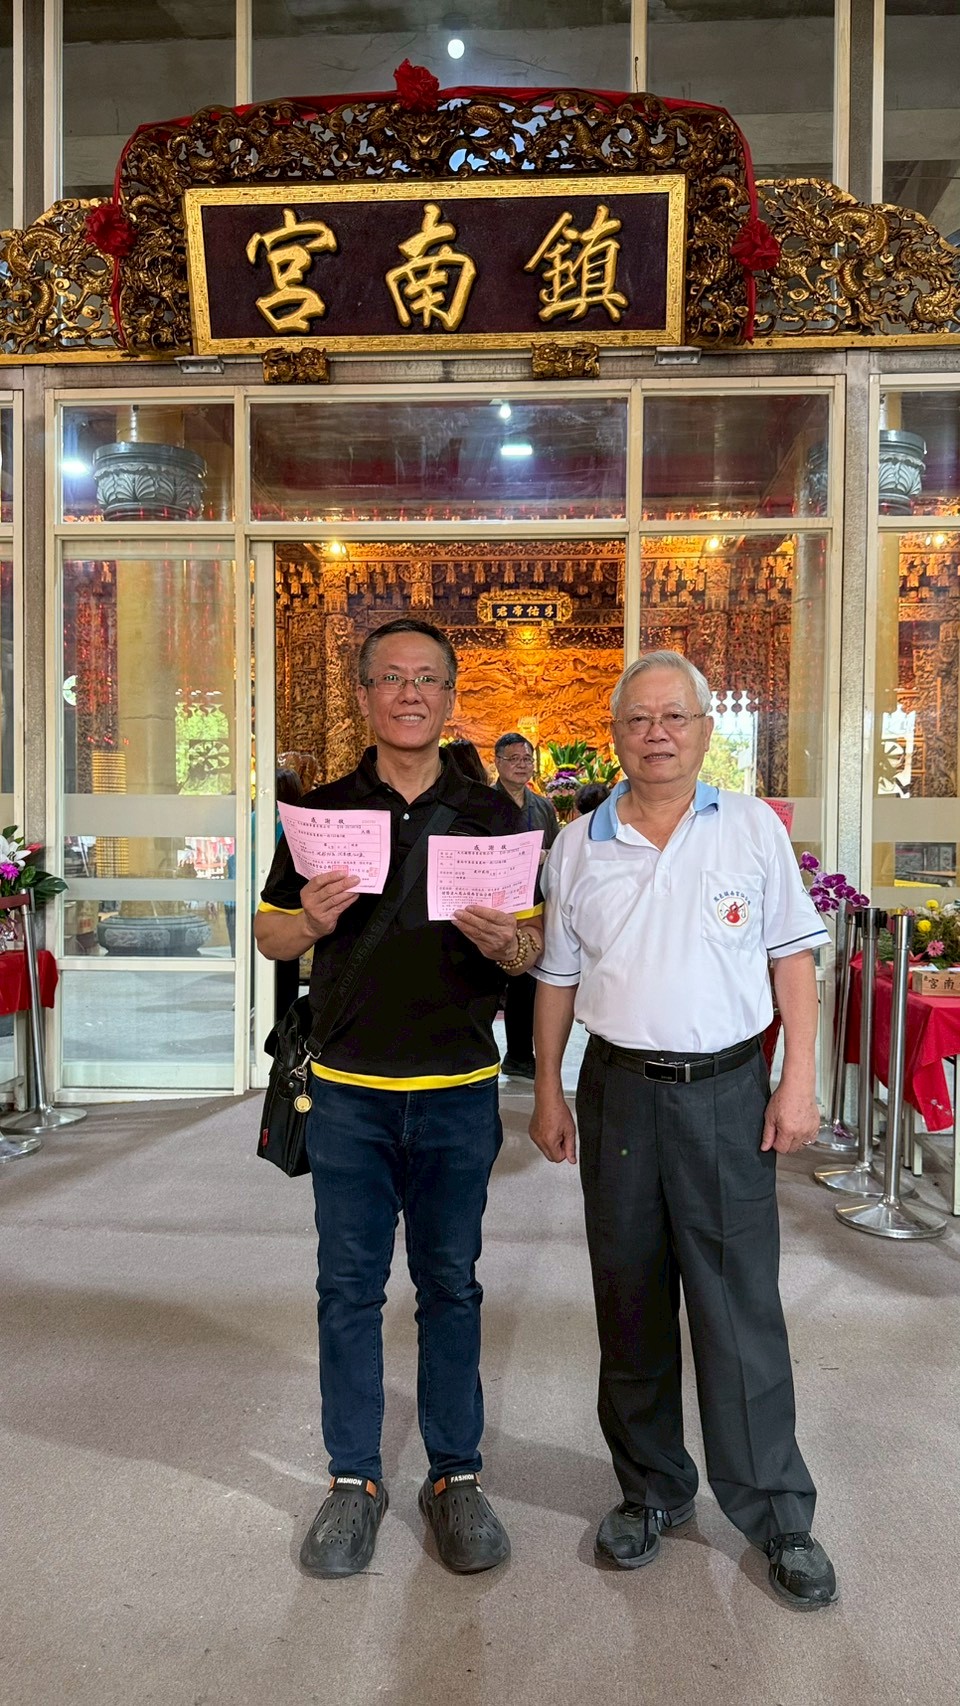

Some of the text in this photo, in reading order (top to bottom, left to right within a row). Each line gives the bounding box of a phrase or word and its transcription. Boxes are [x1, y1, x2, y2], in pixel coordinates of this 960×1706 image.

[246, 203, 629, 333] 鎮南宮
[336, 1476, 363, 1486] FASHION
[450, 1473, 474, 1483] FASHION
